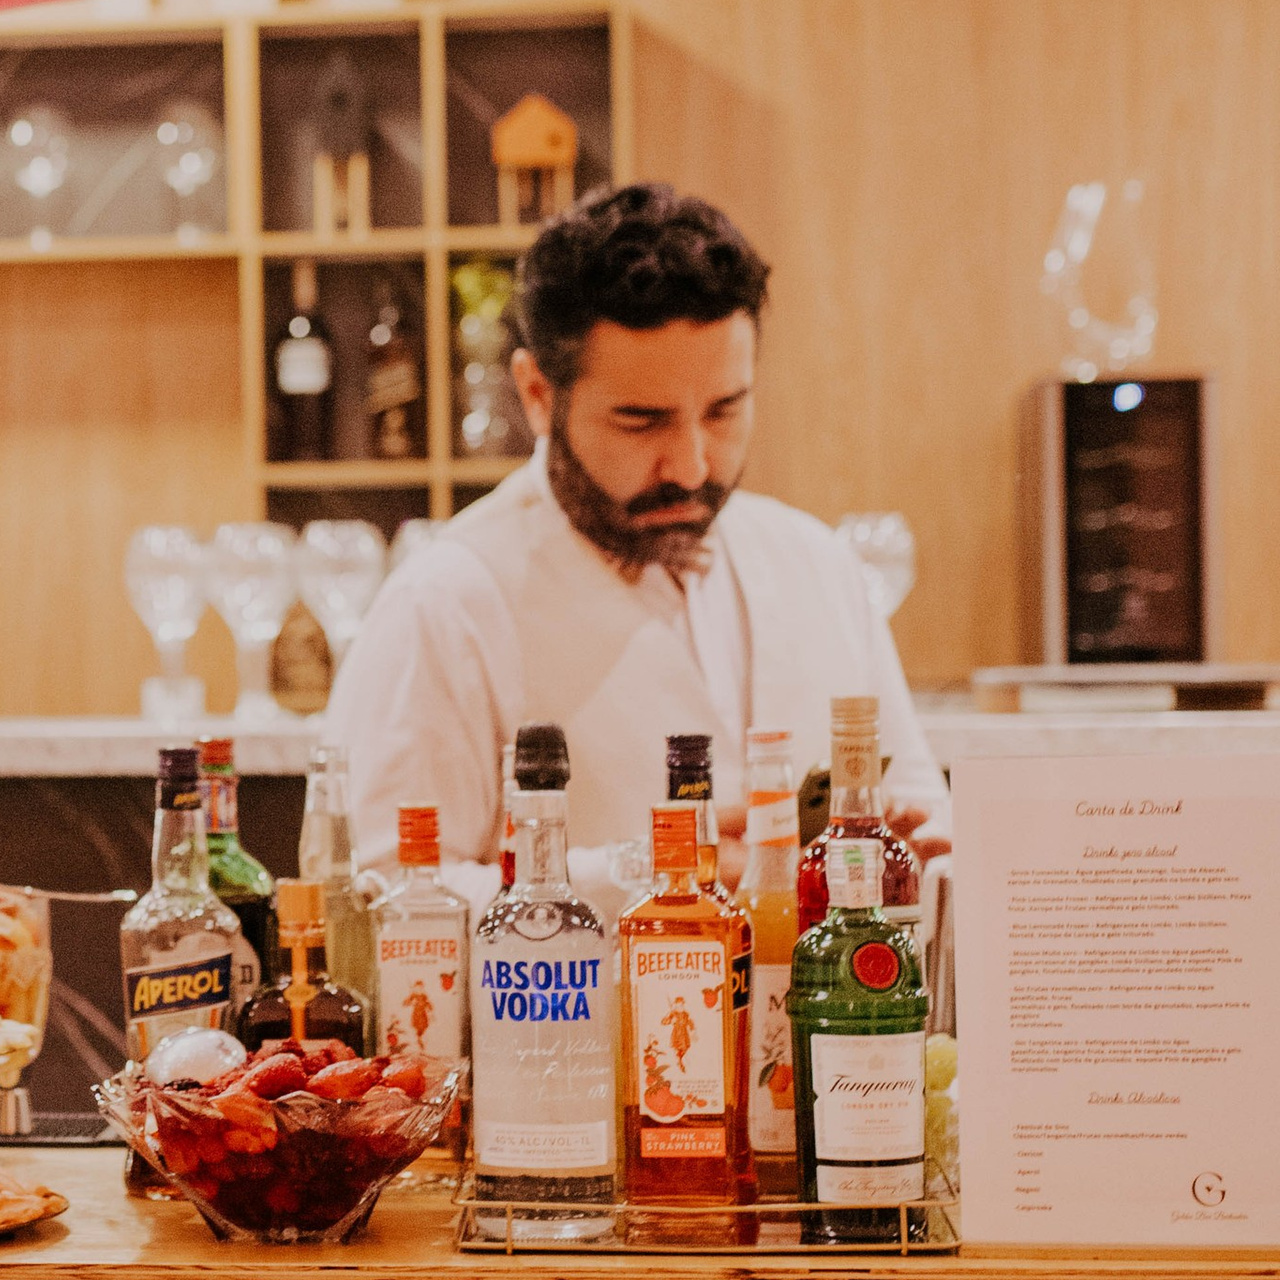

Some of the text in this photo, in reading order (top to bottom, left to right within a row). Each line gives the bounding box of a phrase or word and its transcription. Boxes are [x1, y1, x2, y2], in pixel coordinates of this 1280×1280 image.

[481, 958, 600, 990] ABSOLUT
[637, 952, 721, 977] BEEFEATER
[133, 968, 224, 1012] APEROL
[491, 992, 591, 1021] VODKA
[828, 1074, 917, 1098] Tanqueray
[646, 1140, 721, 1152] STRAWBERRY
